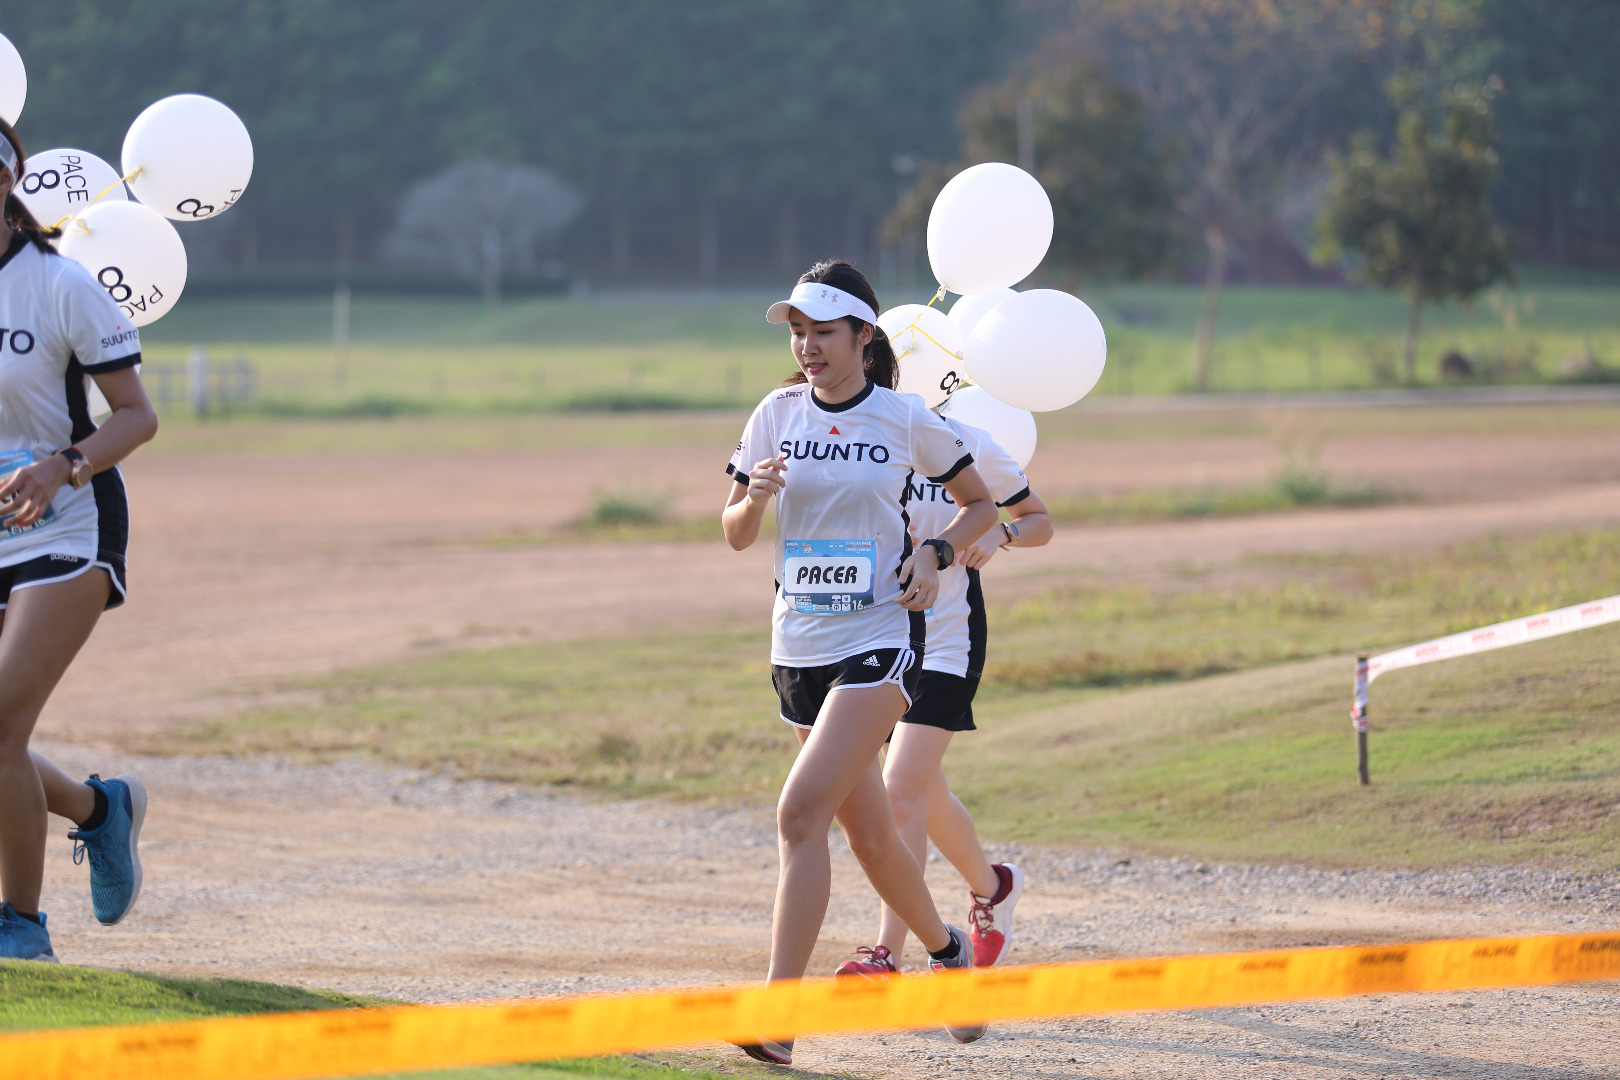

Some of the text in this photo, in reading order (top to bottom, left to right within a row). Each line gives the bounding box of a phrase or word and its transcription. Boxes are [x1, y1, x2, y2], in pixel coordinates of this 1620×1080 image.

[22, 169, 60, 195] 8
[60, 155, 89, 203] PACE
[176, 198, 215, 218] 8
[97, 266, 132, 303] 8
[101, 329, 138, 348] SUUNTO
[940, 370, 960, 396] 8
[780, 440, 890, 464] SUUNTO
[796, 565, 858, 585] PACER
[852, 599, 864, 611] 16
